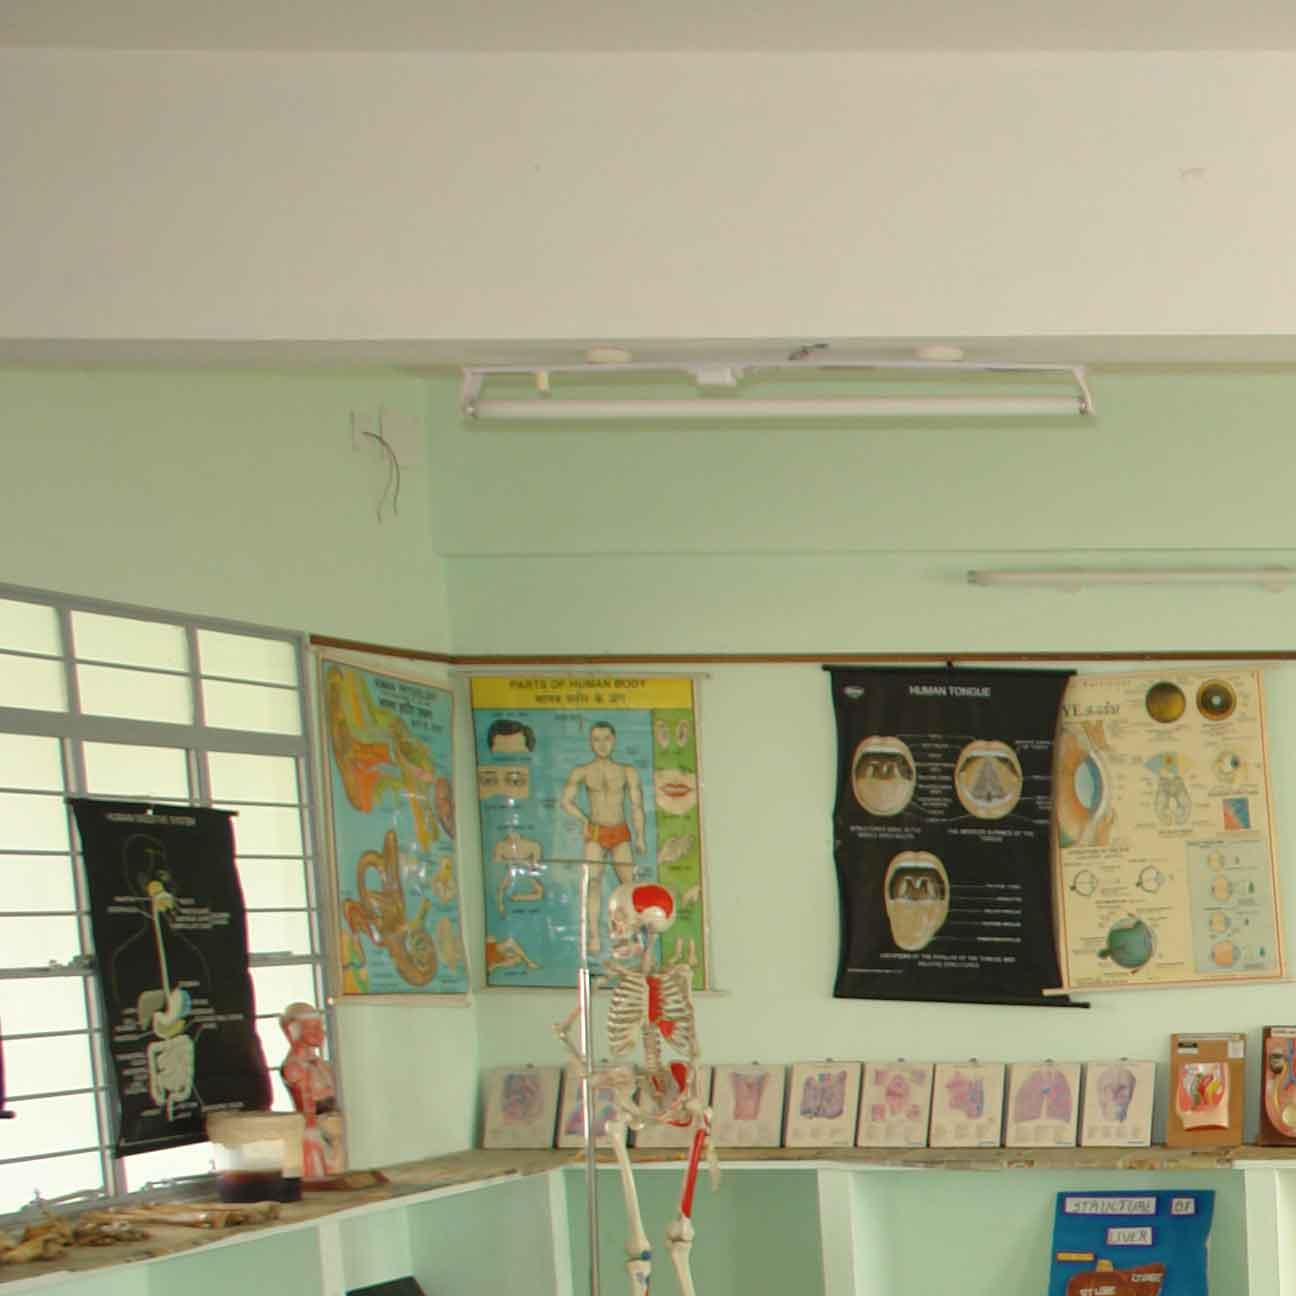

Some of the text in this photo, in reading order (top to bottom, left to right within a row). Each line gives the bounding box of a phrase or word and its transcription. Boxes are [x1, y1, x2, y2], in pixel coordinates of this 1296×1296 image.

[509, 680, 645, 690] PARTS OF HUMAN BODY
[909, 685, 991, 697] HUMAN TONGUE
